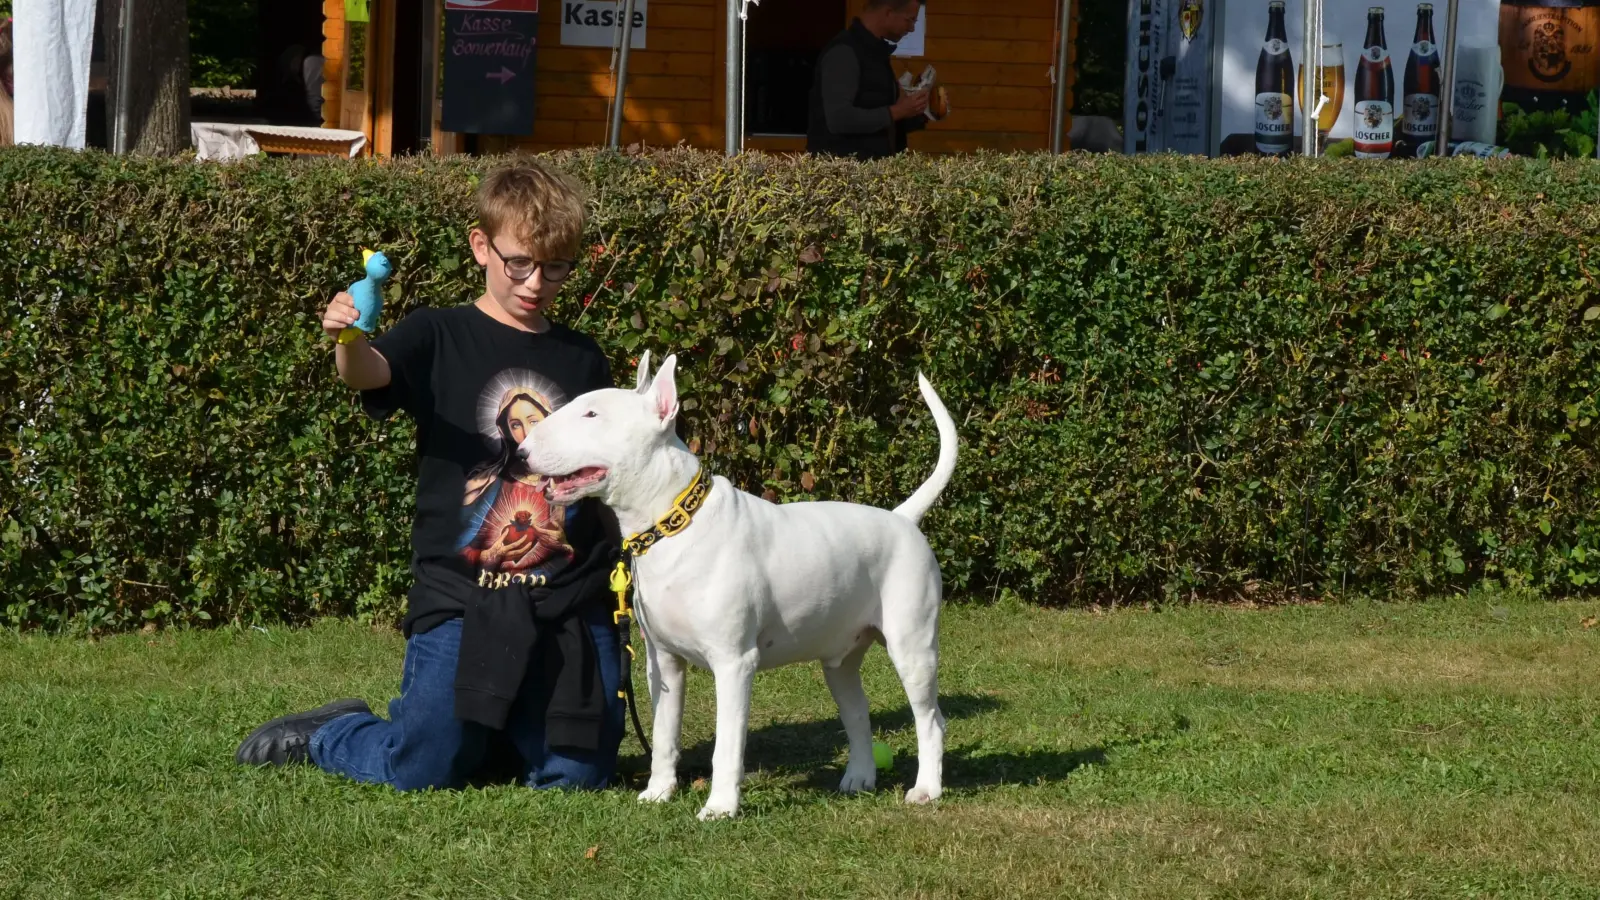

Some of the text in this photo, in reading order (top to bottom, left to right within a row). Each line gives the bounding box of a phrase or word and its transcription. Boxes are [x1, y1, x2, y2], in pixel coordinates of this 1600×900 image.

[461, 13, 512, 32] Kasse
[565, 3, 644, 28] Kasse
[1355, 130, 1390, 140] LOSCHER
